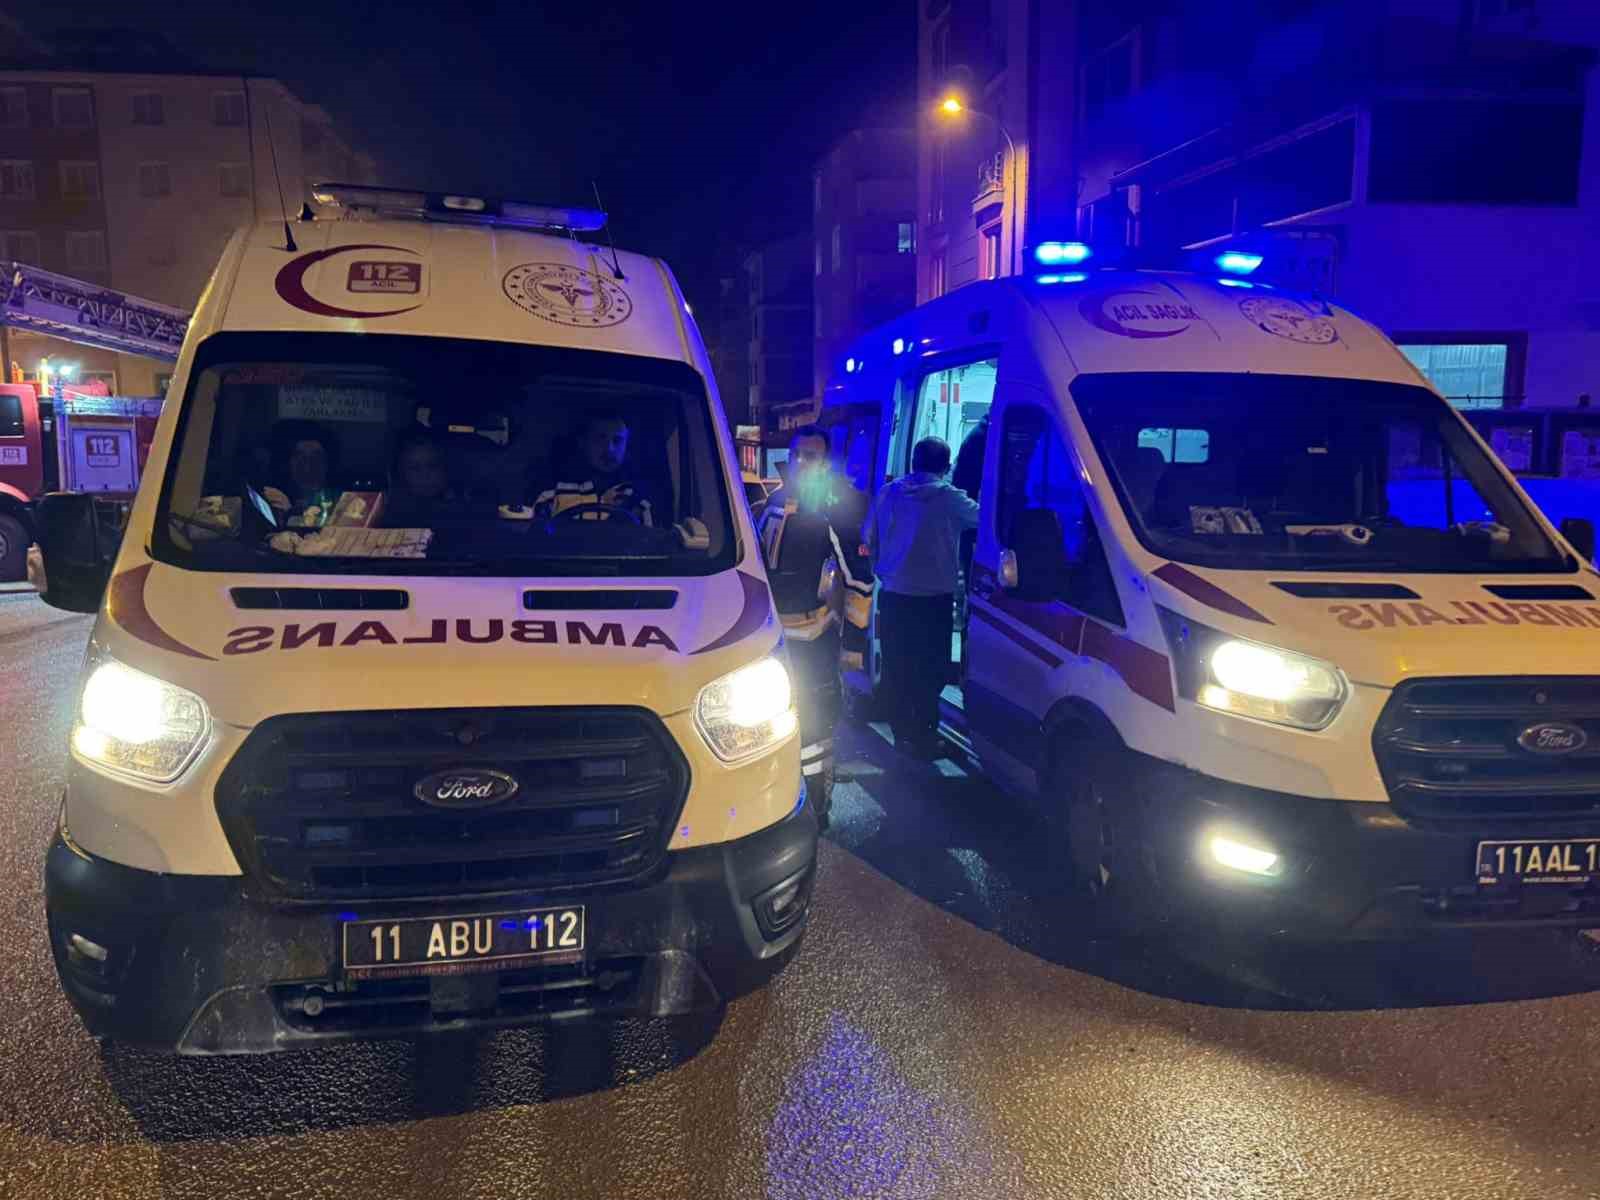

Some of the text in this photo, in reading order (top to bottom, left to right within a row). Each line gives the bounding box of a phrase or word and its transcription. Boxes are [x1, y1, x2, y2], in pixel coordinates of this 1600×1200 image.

[360, 263, 409, 280] 112
[90, 438, 115, 454] 112
[1537, 728, 1575, 748] Ford
[437, 776, 495, 799] Ford
[371, 910, 578, 962] 11 ABU 112
